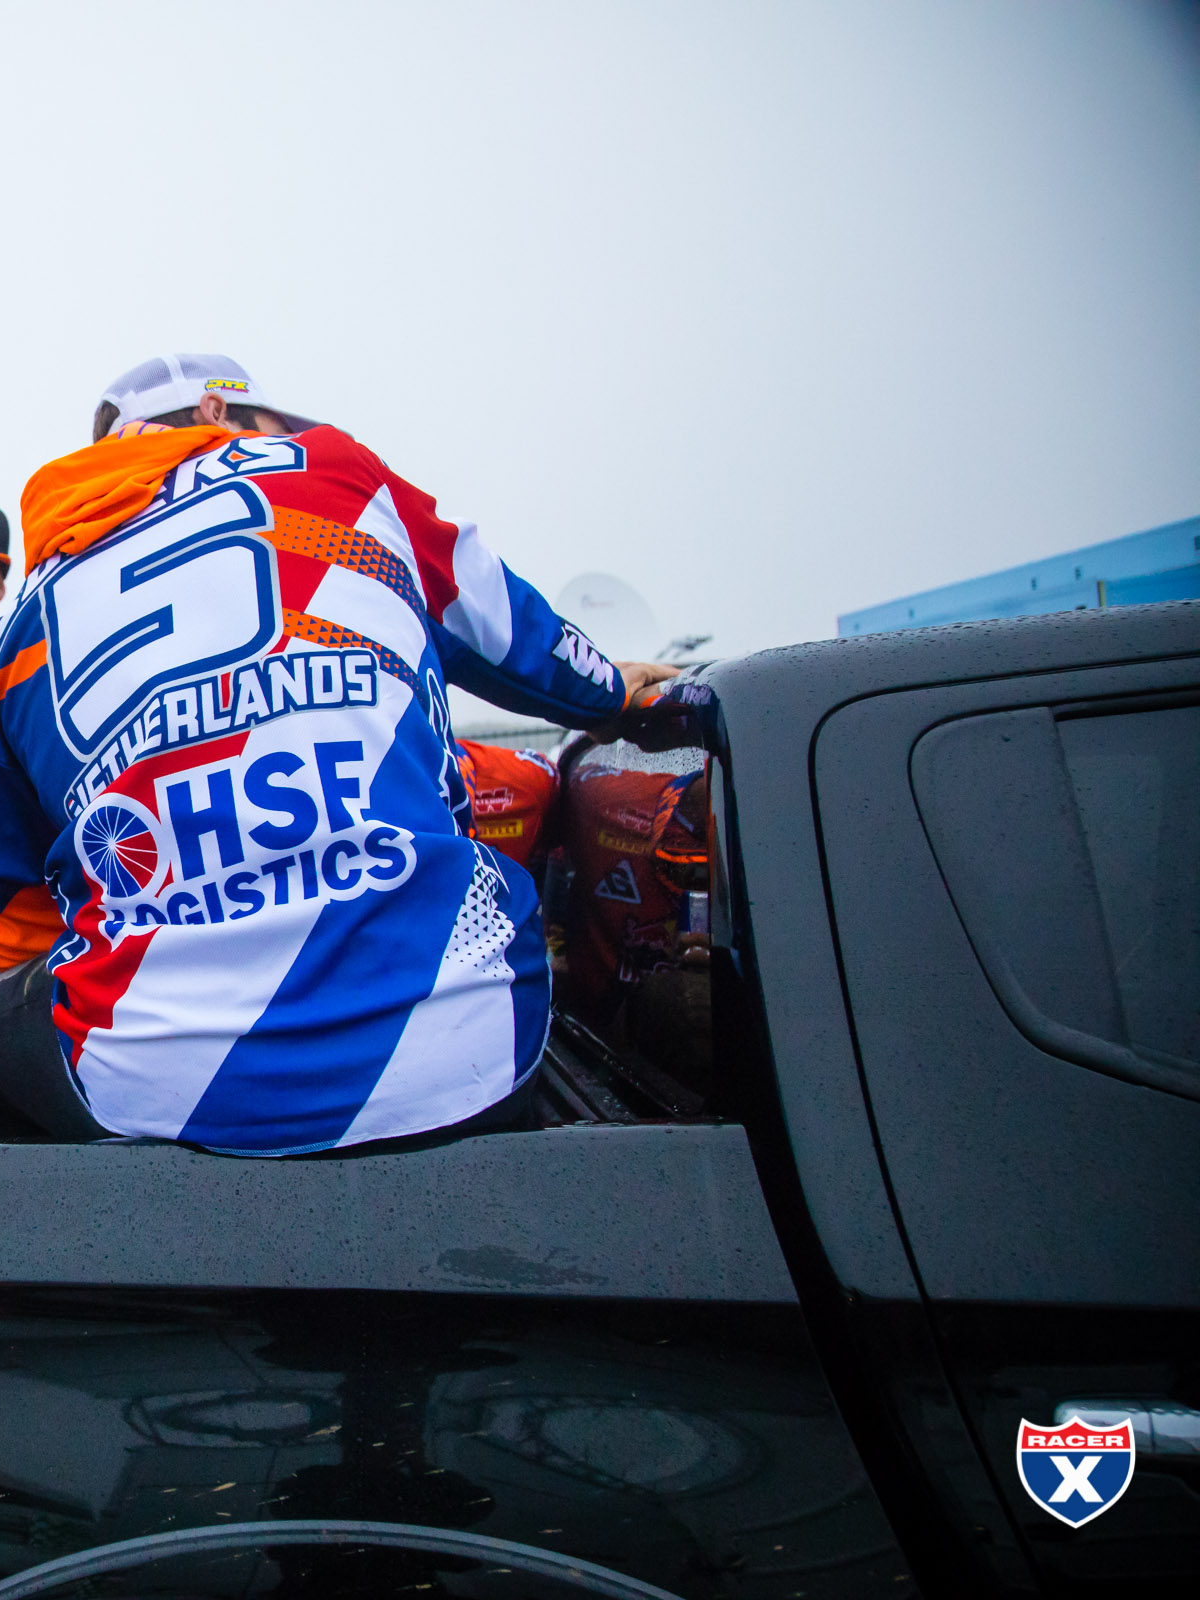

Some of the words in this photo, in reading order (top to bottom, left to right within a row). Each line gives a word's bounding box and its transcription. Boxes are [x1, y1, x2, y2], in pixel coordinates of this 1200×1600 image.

[50, 480, 283, 760] 5
[552, 622, 614, 693] KTM
[165, 740, 366, 882] HSF
